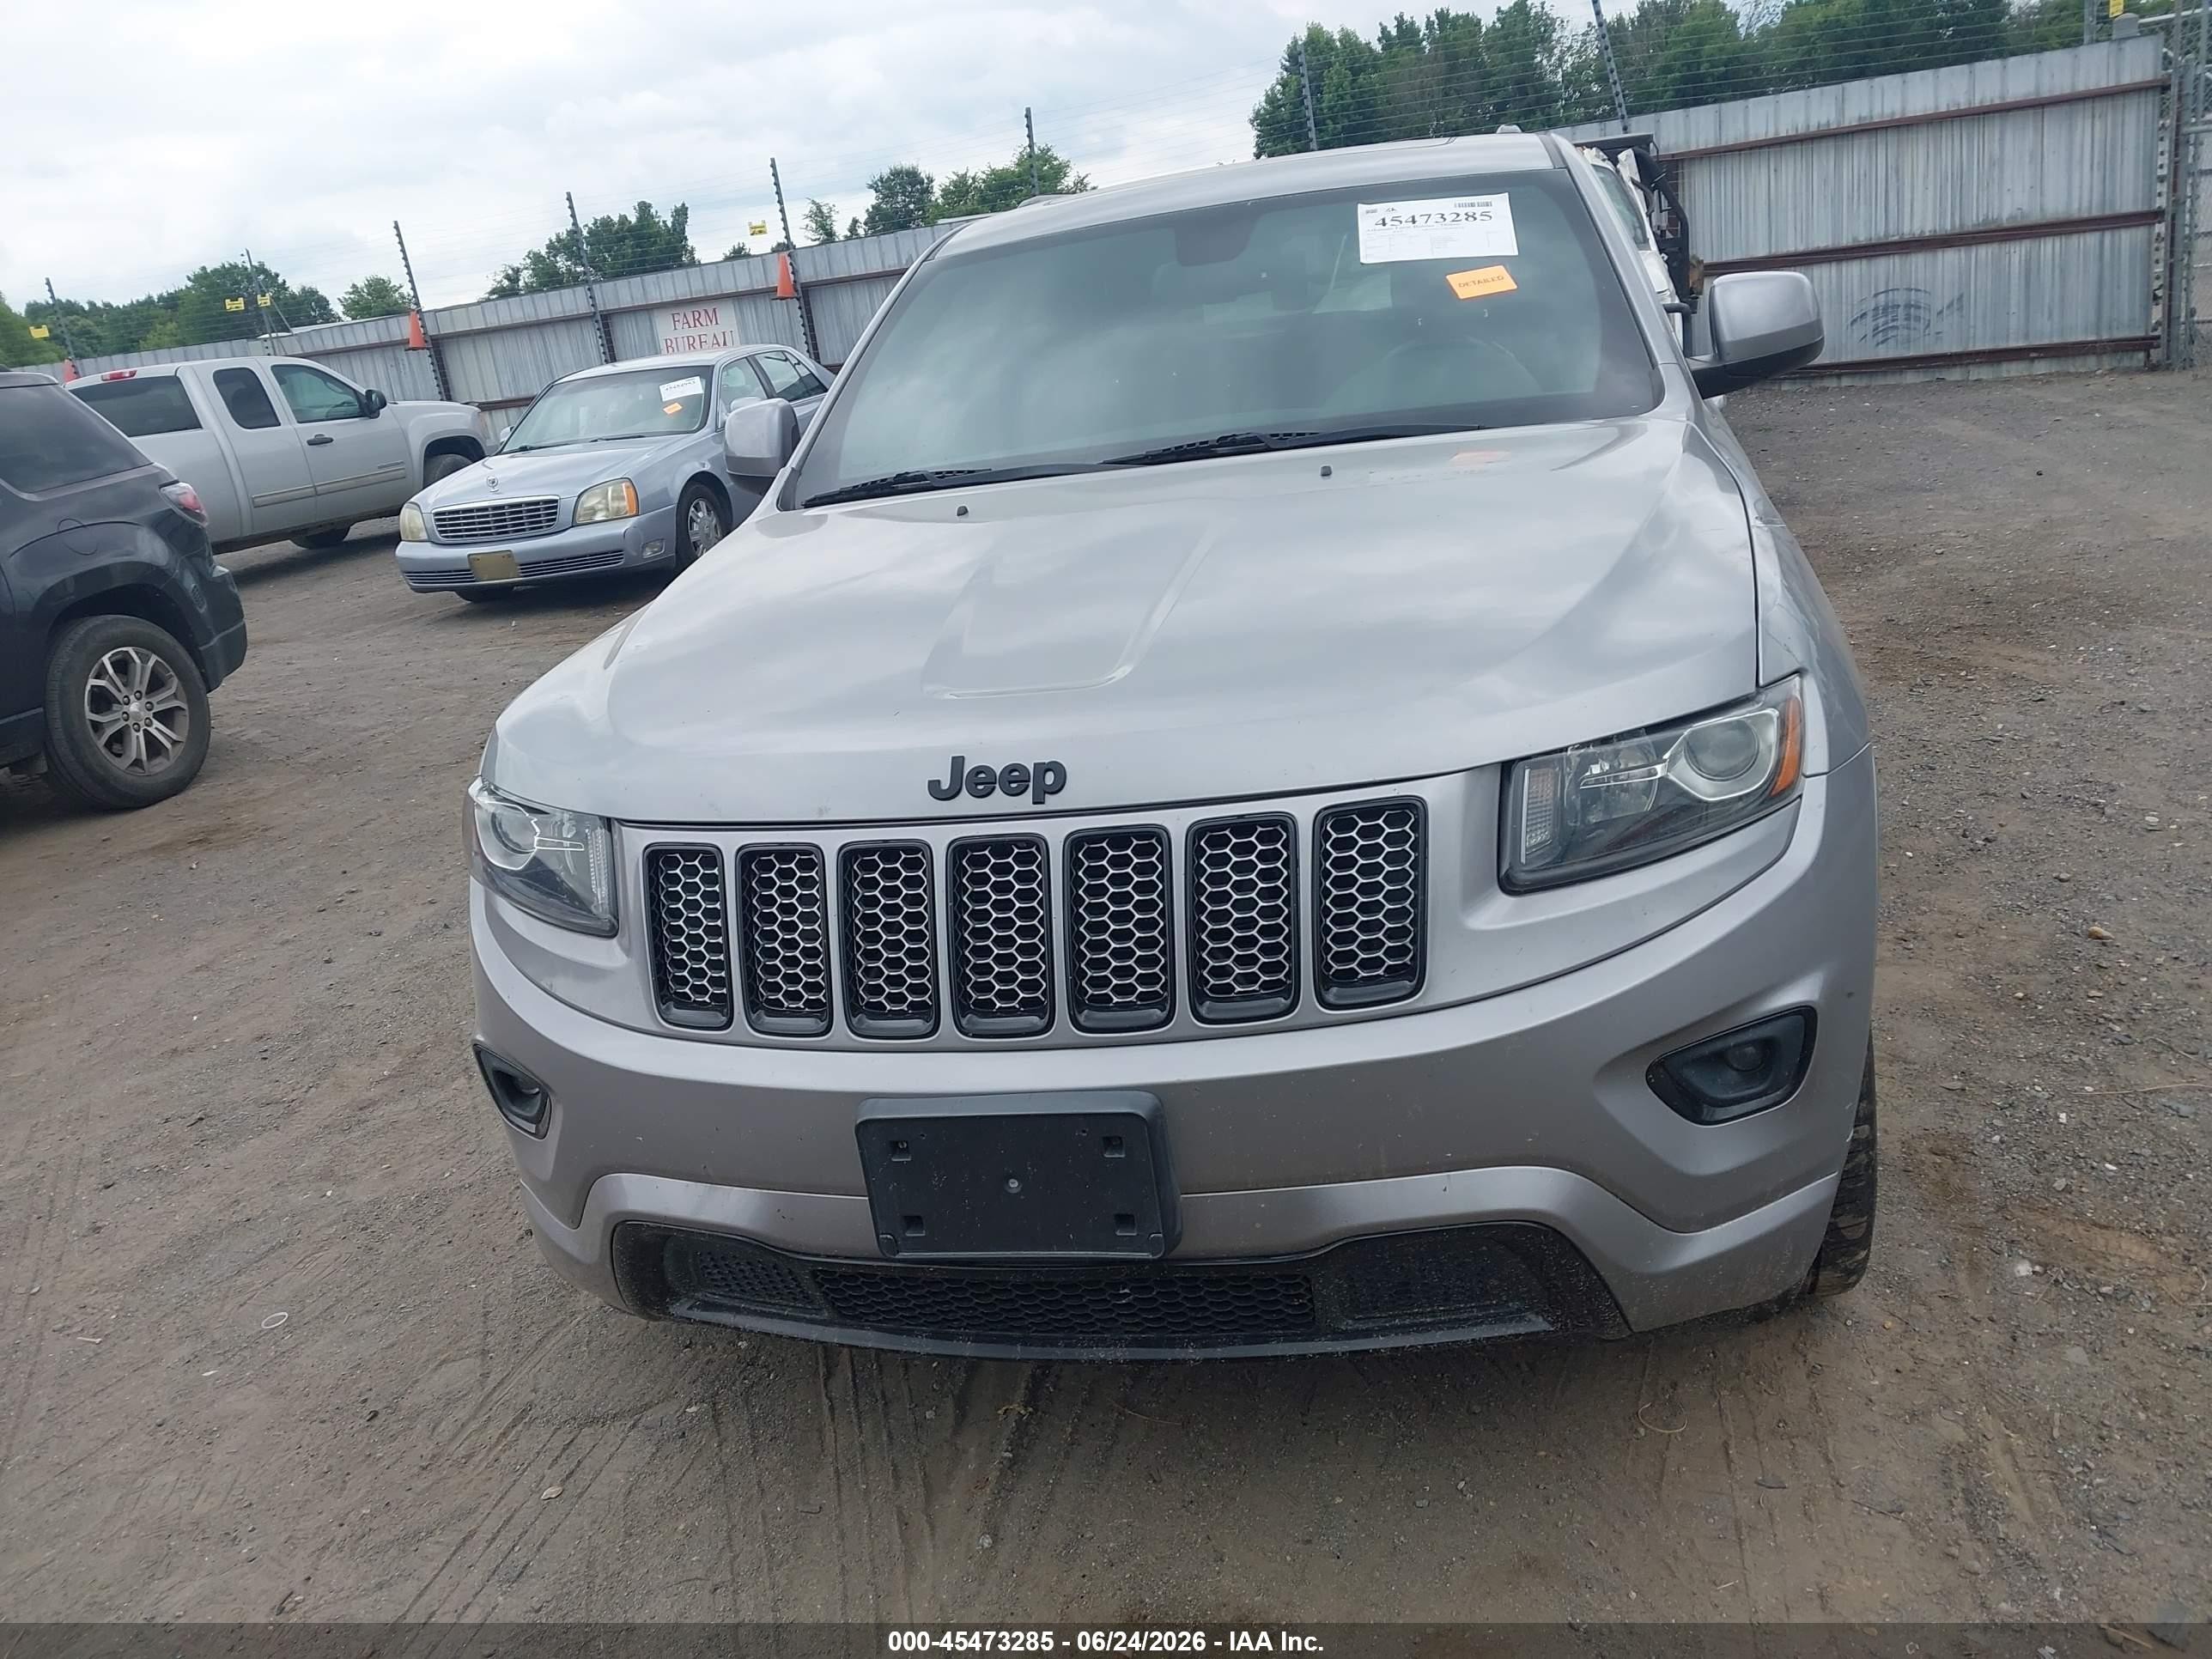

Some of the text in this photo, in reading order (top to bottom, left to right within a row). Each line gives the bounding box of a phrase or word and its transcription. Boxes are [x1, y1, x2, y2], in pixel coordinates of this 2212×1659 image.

[1375, 210, 1493, 227] 45473285
[1458, 275, 1504, 288] DETAILED
[672, 307, 720, 331] FARM
[664, 330, 734, 354] BUREAU
[927, 756, 1067, 805] Jeep
